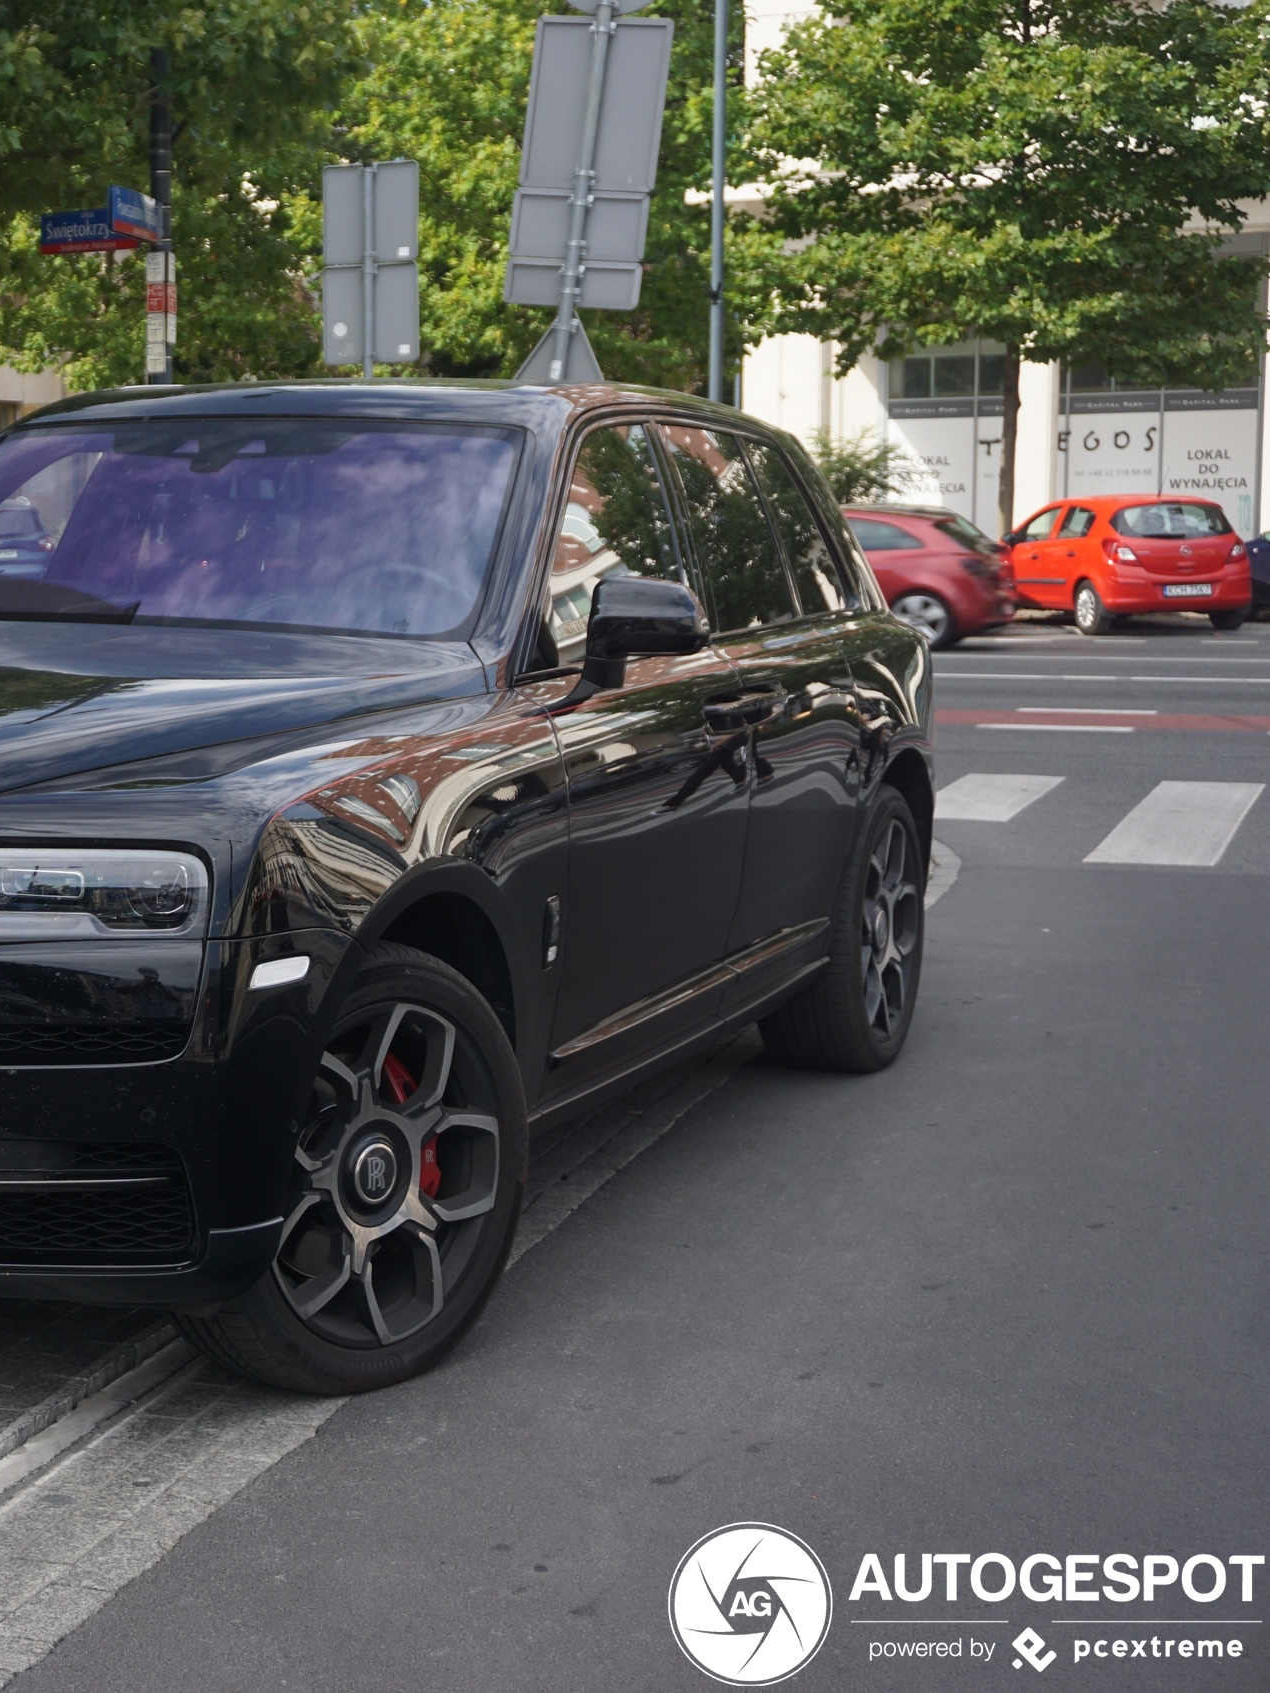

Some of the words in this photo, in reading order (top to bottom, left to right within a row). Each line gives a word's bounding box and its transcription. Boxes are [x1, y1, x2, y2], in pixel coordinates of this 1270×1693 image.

[81, 210, 94, 218] ulica
[46, 220, 116, 241] Świętokrzy
[1187, 449, 1231, 460] LOKAL
[1142, 467, 1152, 475] 88
[1198, 463, 1219, 474] DO
[1169, 477, 1248, 491] WYNAJĘCIA
[1168, 585, 1187, 595] KCH
[1189, 584, 1210, 594] 75K7
